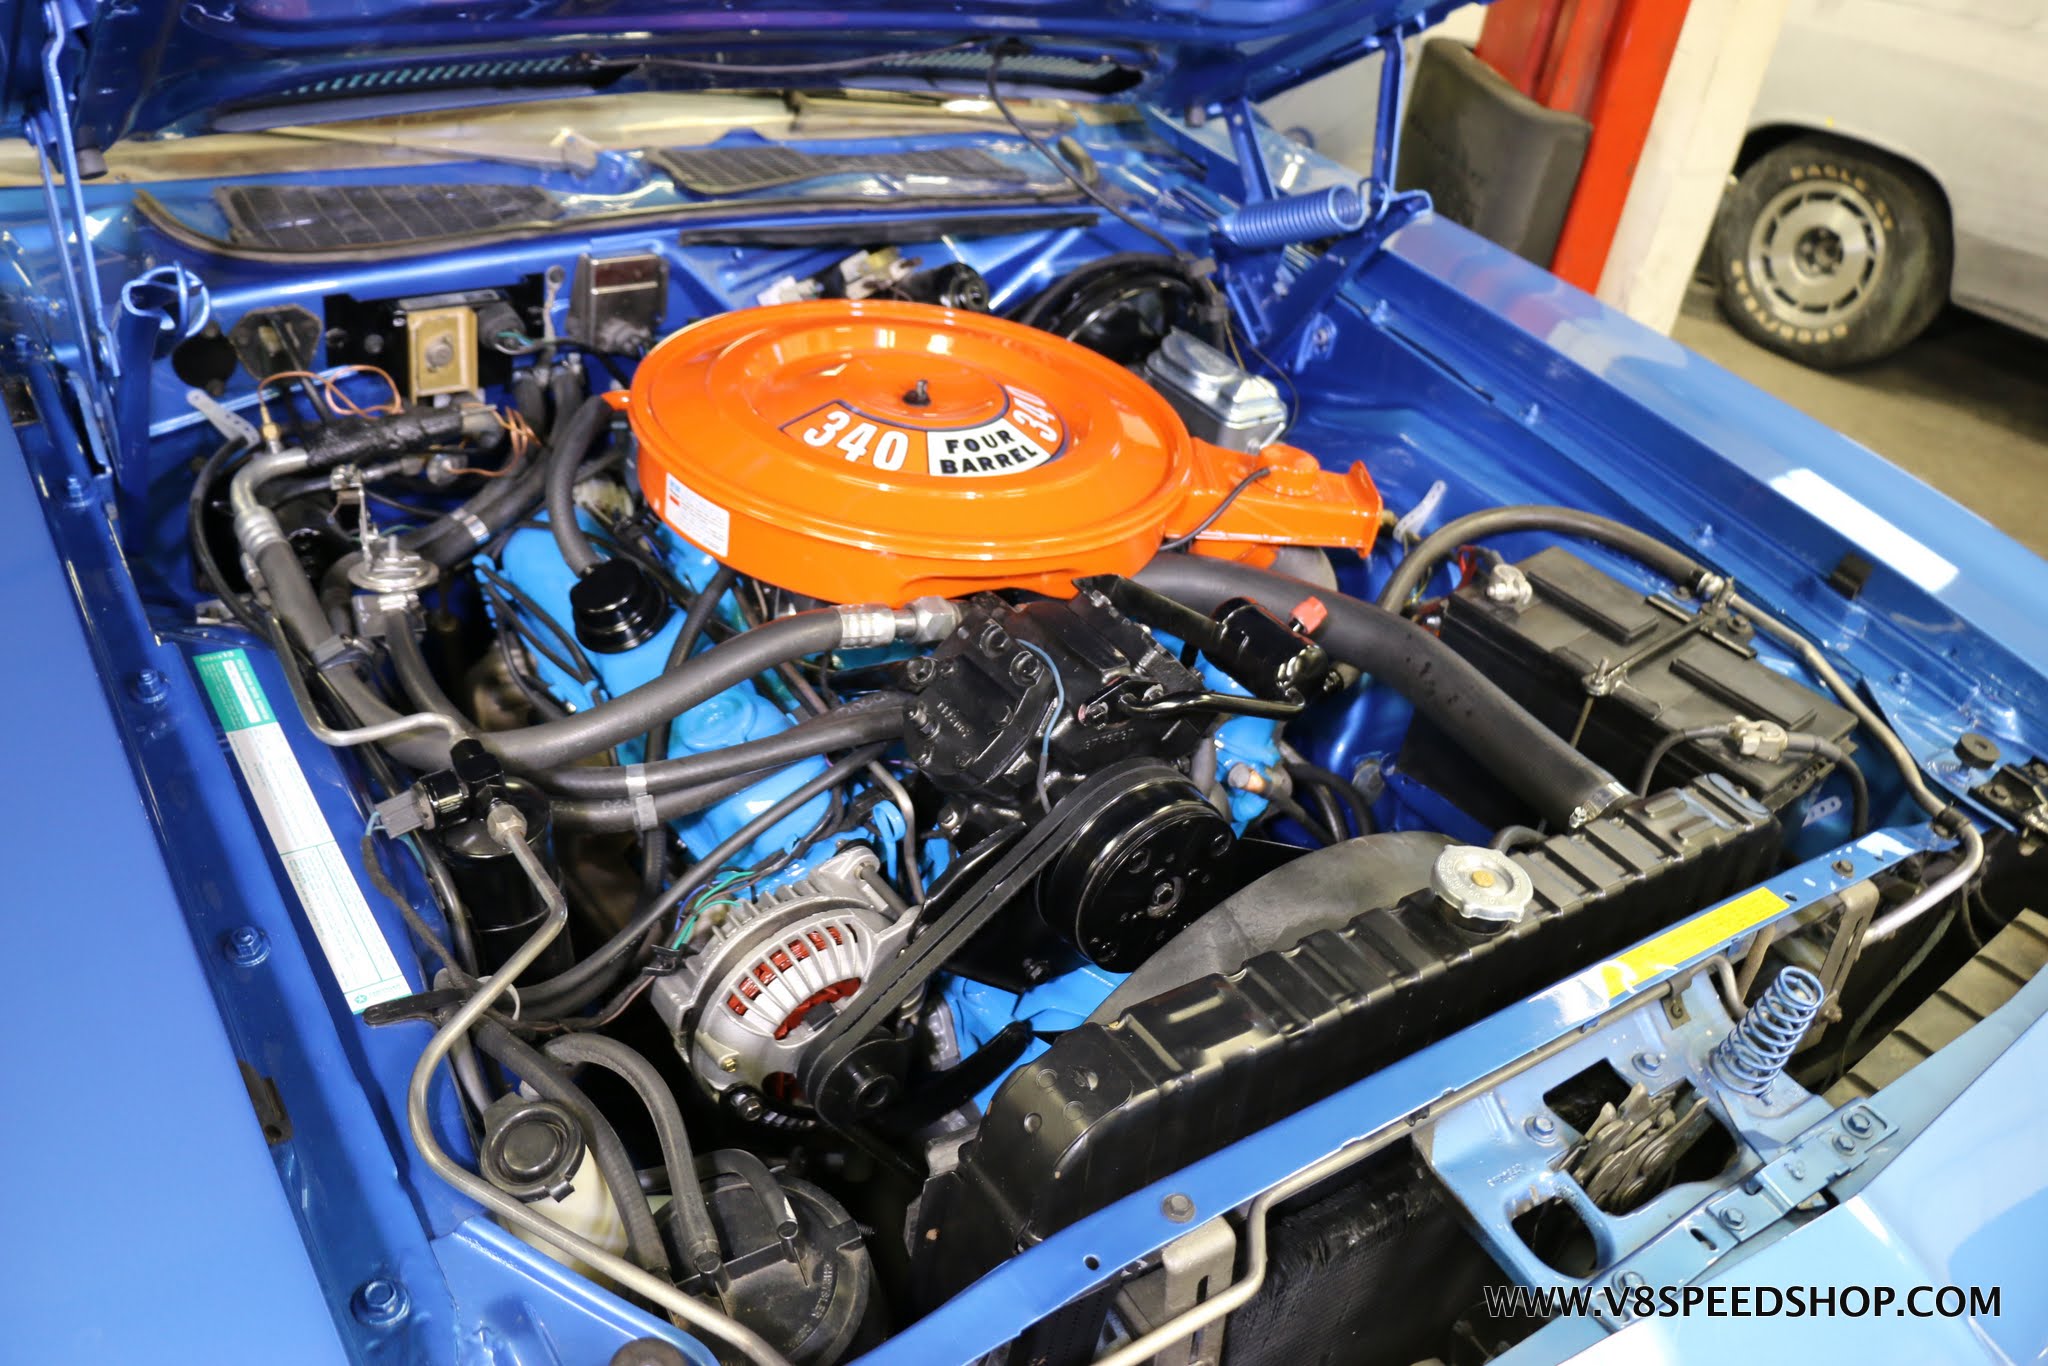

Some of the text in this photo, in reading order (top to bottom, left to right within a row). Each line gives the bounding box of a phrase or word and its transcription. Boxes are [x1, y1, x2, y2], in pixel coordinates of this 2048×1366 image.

[1789, 165, 1867, 193] EAGLE
[1004, 384, 1058, 442] 340
[803, 410, 909, 472] 340
[945, 430, 1016, 454] FOUR
[940, 444, 1038, 475] BARREL
